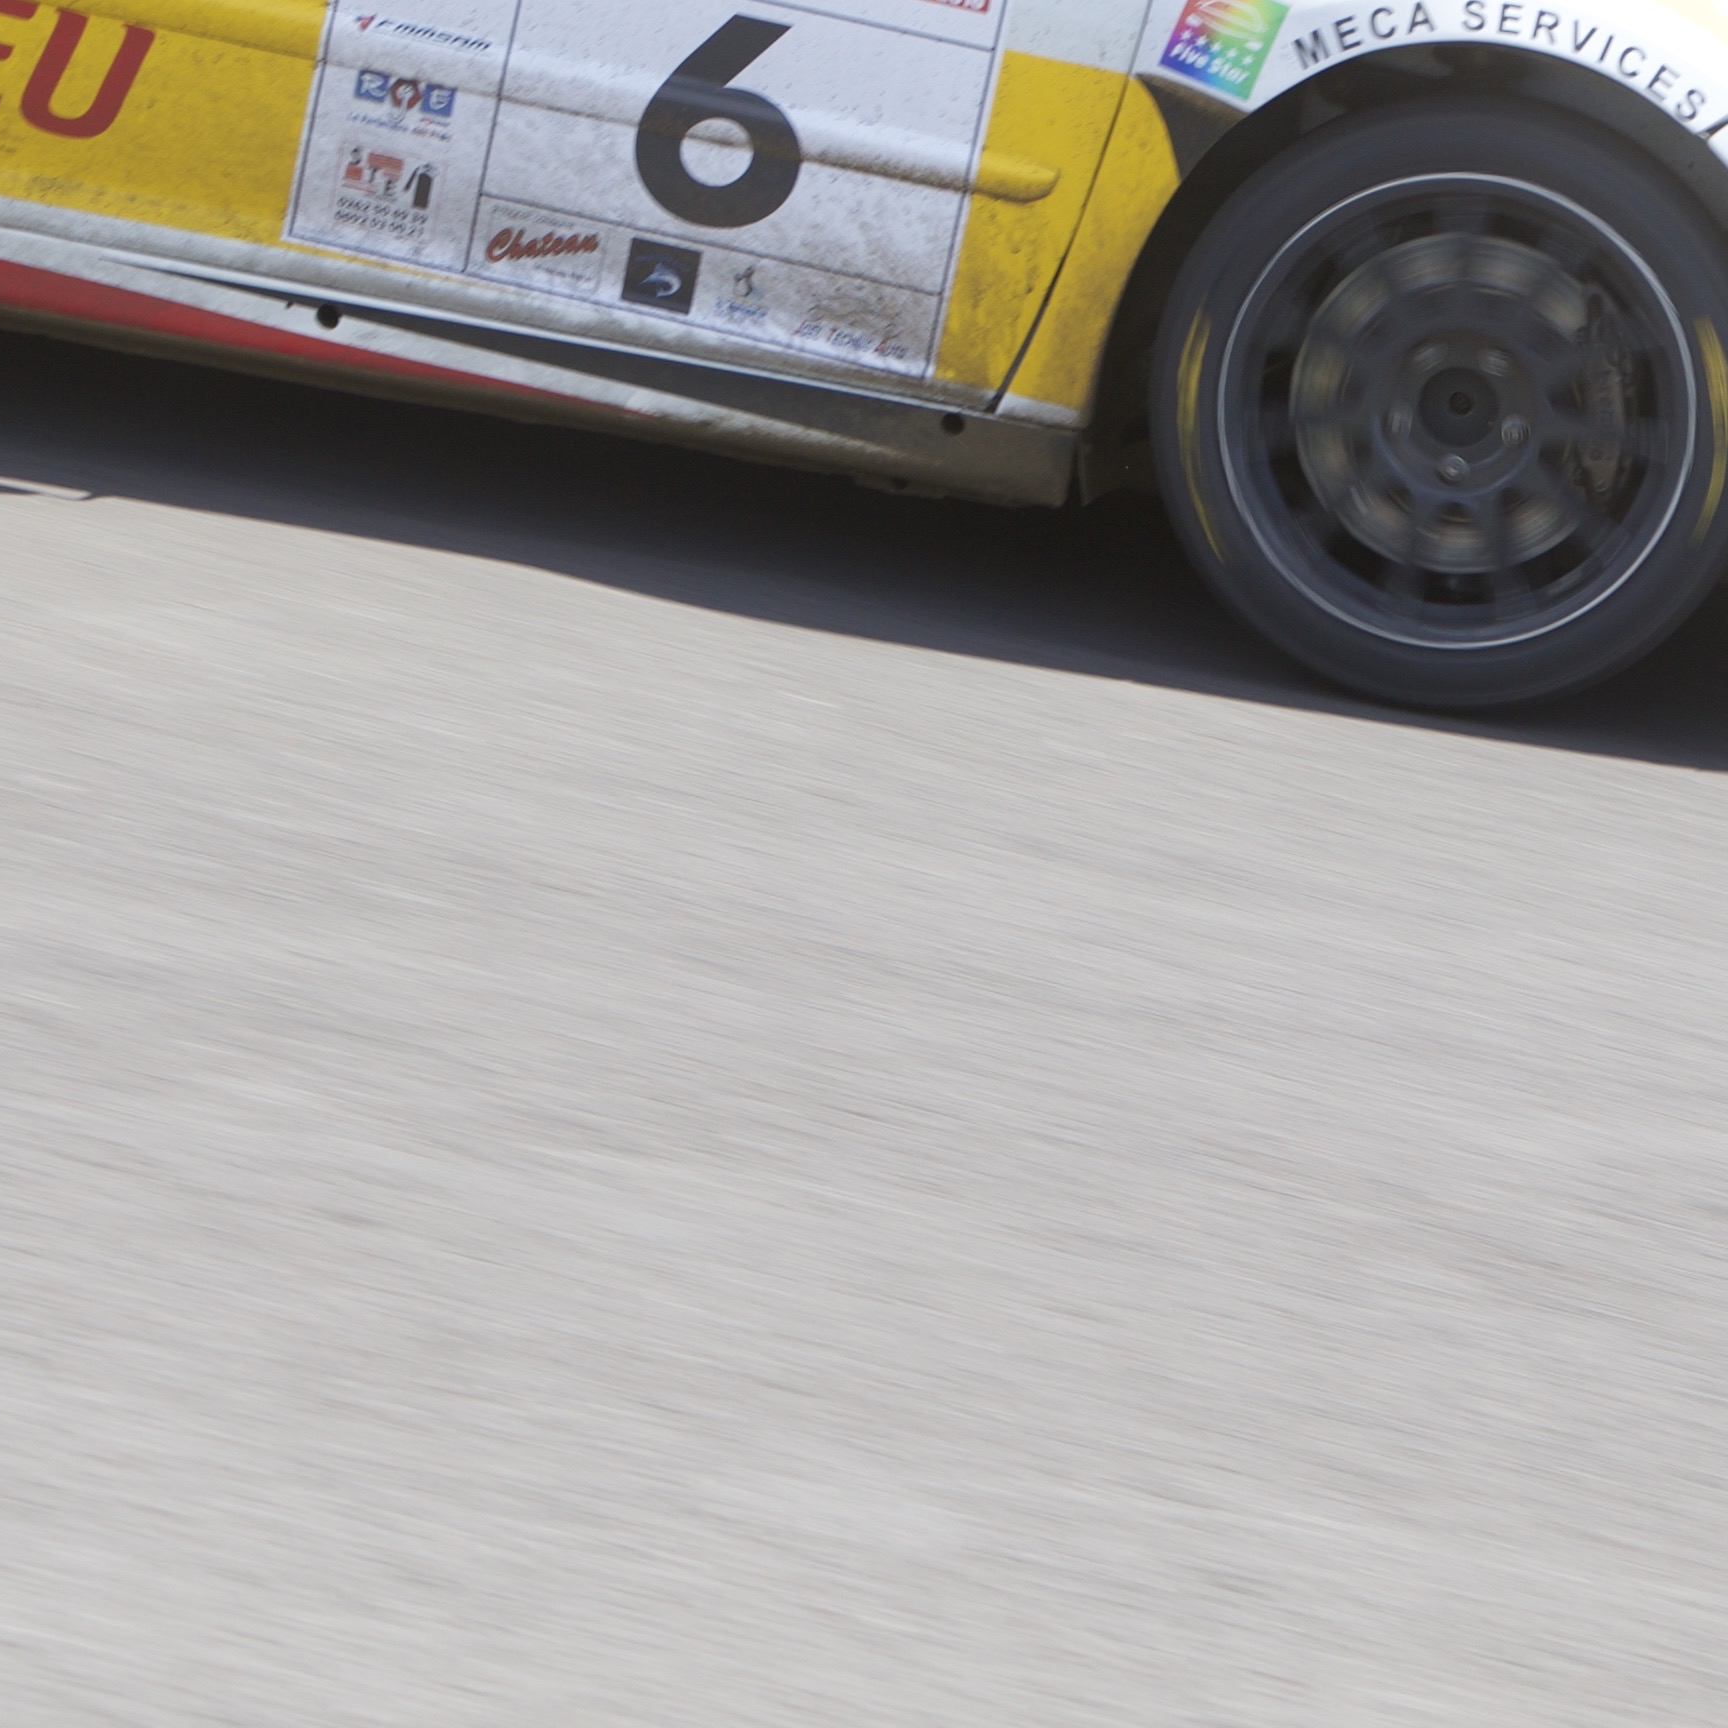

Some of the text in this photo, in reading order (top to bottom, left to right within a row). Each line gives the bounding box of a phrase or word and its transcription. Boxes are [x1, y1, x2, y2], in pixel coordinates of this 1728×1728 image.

[635, 15, 804, 229] 6
[1170, 41, 1251, 85] Five Star
[1292, 0, 1708, 125] MECA SERVICES
